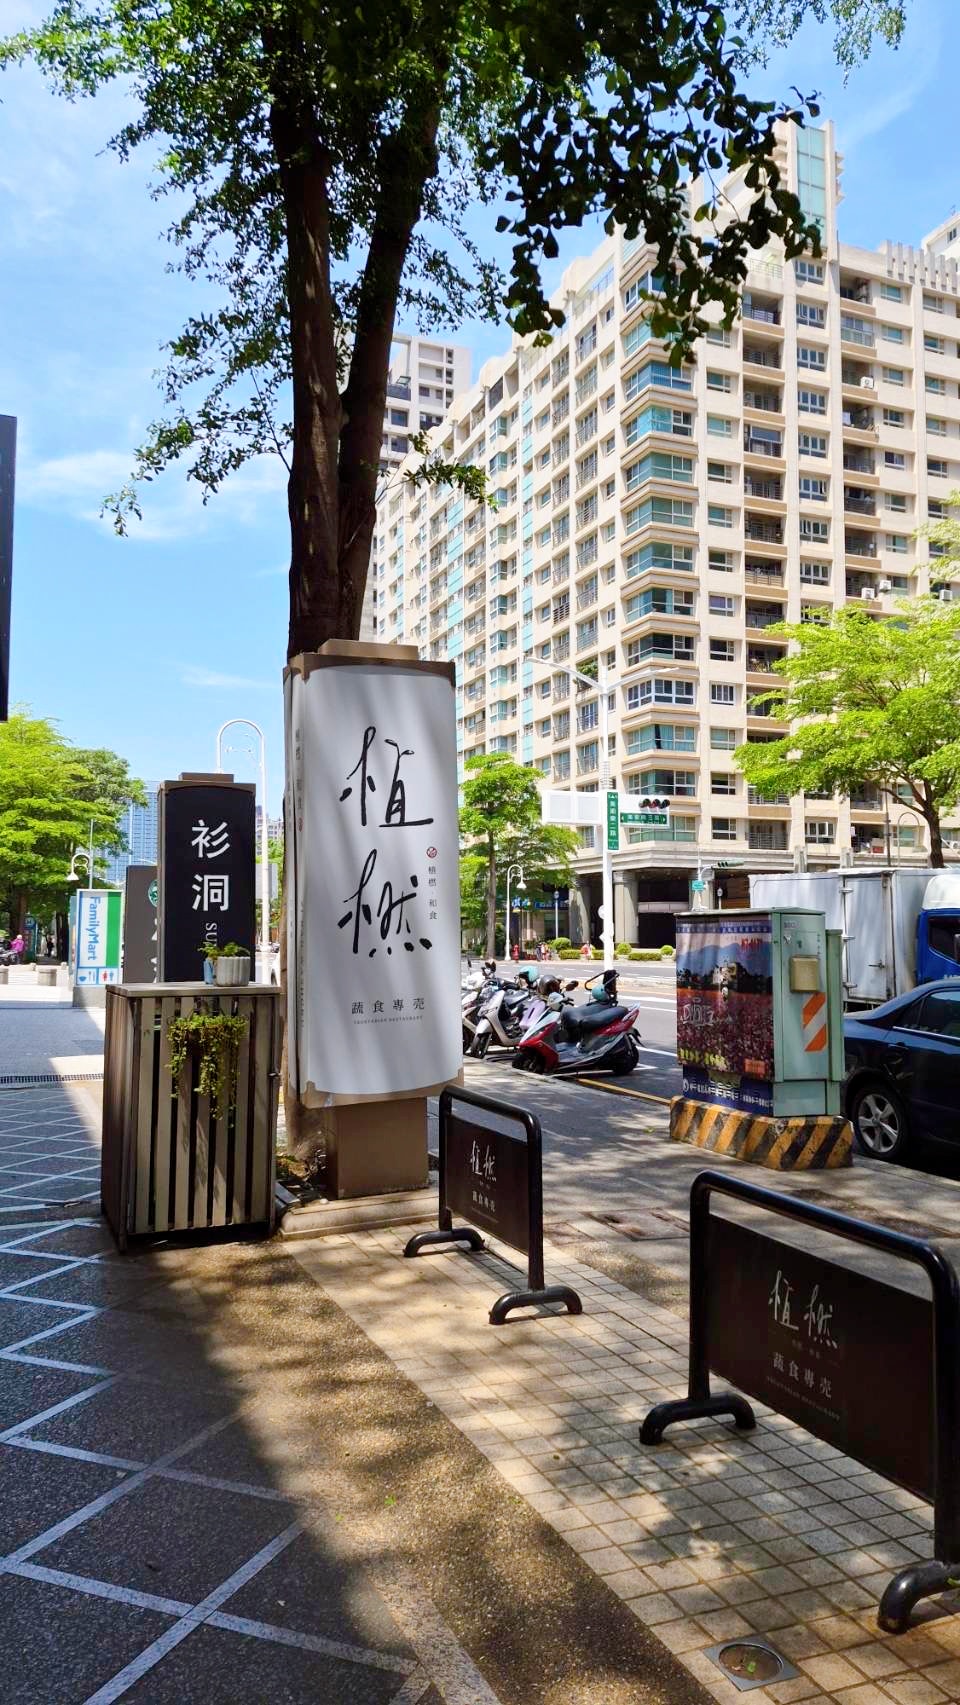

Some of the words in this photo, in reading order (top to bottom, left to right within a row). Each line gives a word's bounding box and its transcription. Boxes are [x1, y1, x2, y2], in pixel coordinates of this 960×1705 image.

[191, 819, 231, 912] 衫洞
[87, 896, 101, 960] FamilyMart
[205, 922, 217, 947] SU
